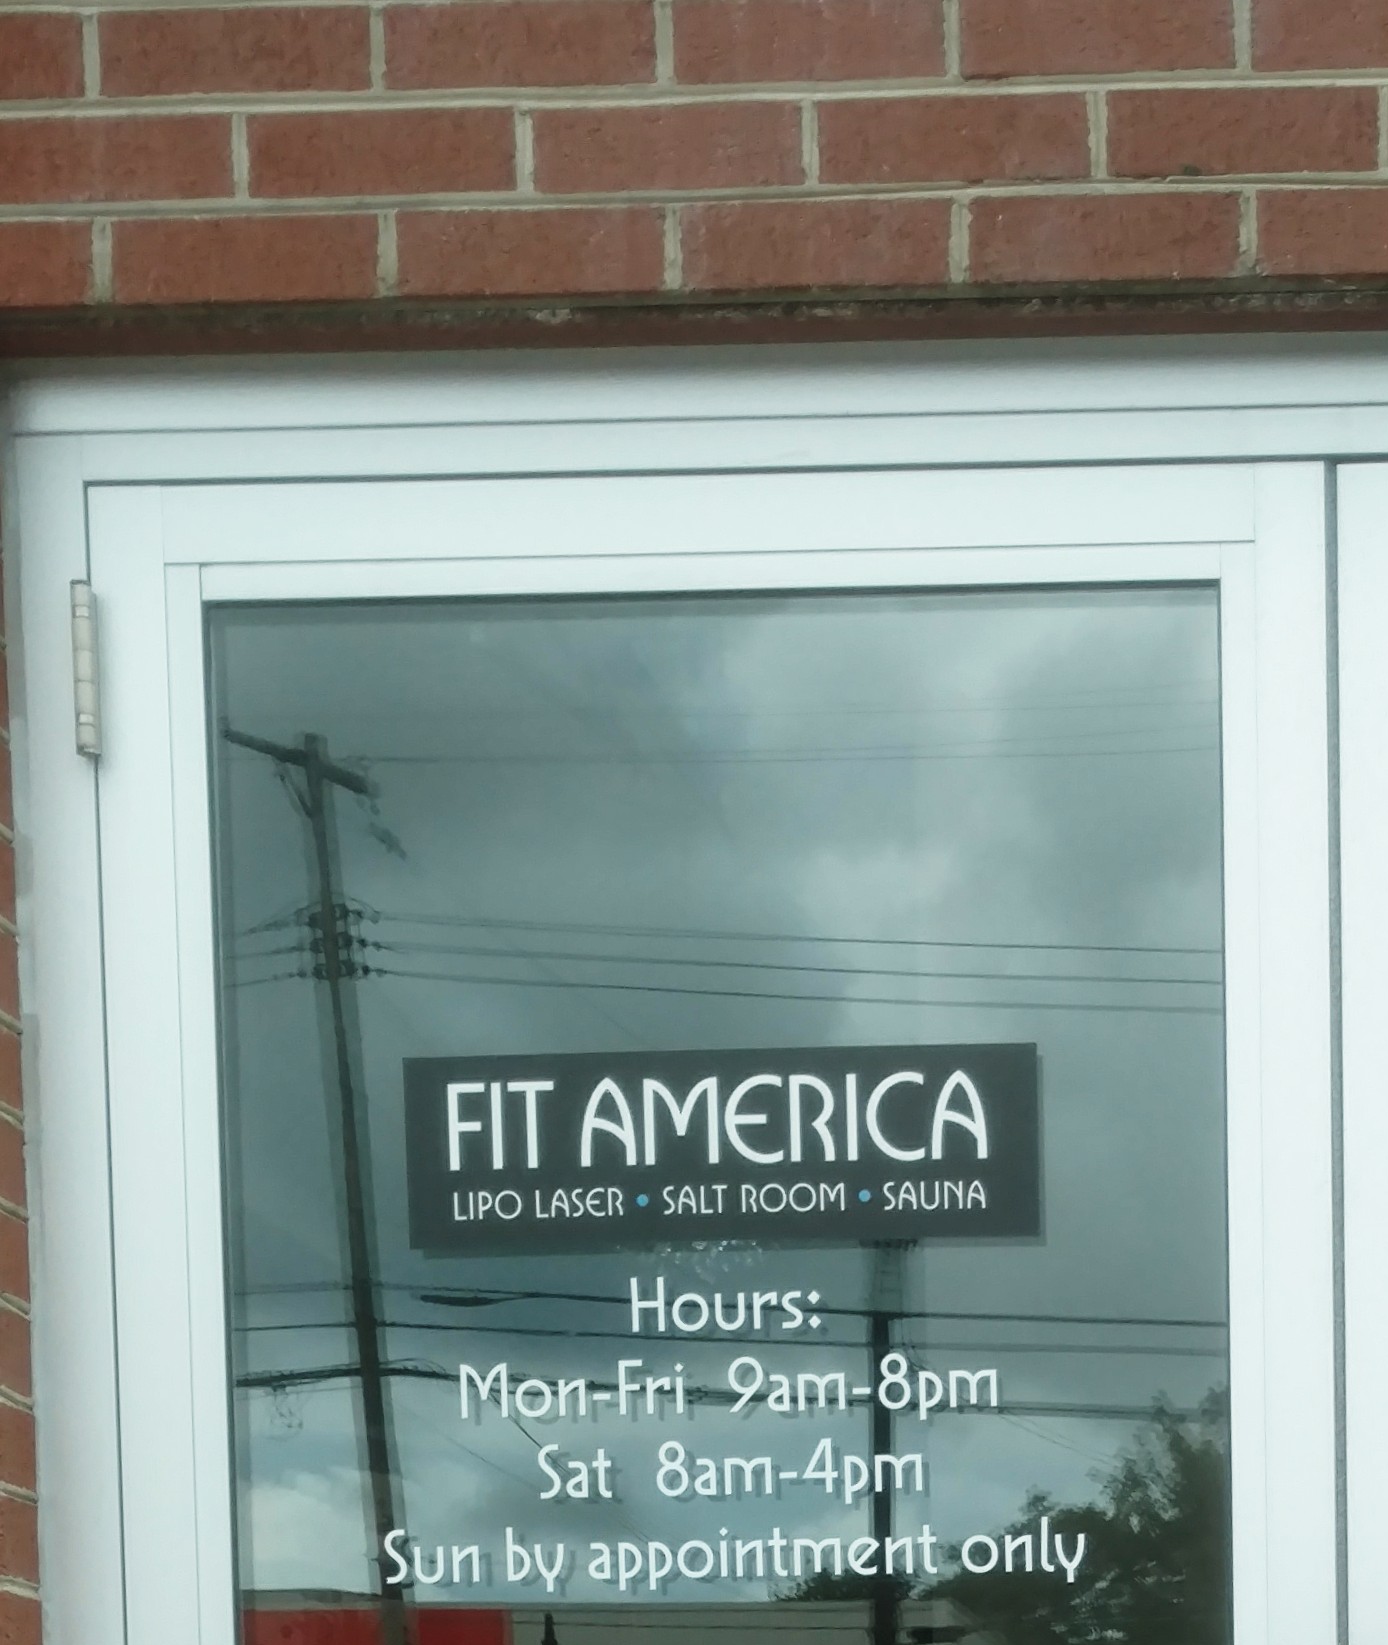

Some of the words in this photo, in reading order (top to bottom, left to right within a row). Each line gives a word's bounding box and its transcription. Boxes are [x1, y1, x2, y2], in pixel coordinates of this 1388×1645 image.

[447, 1080, 554, 1171] FIT
[580, 1070, 988, 1167] AMERICA
[453, 1190, 522, 1221] LIPO
[535, 1187, 624, 1218] LASER
[663, 1184, 728, 1215] SALT
[741, 1182, 845, 1213] ROOM
[883, 1180, 986, 1210] SAUNA
[630, 1276, 822, 1333] Hours:
[459, 1359, 684, 1420] Mon-Fri
[727, 1352, 998, 1421] 9am-8pm
[537, 1443, 613, 1500] Sat
[655, 1437, 923, 1505] 8am-4pm
[384, 1528, 480, 1585] Sun
[505, 1526, 565, 1593] by
[587, 1521, 938, 1592] appointment
[961, 1516, 1085, 1583] only
